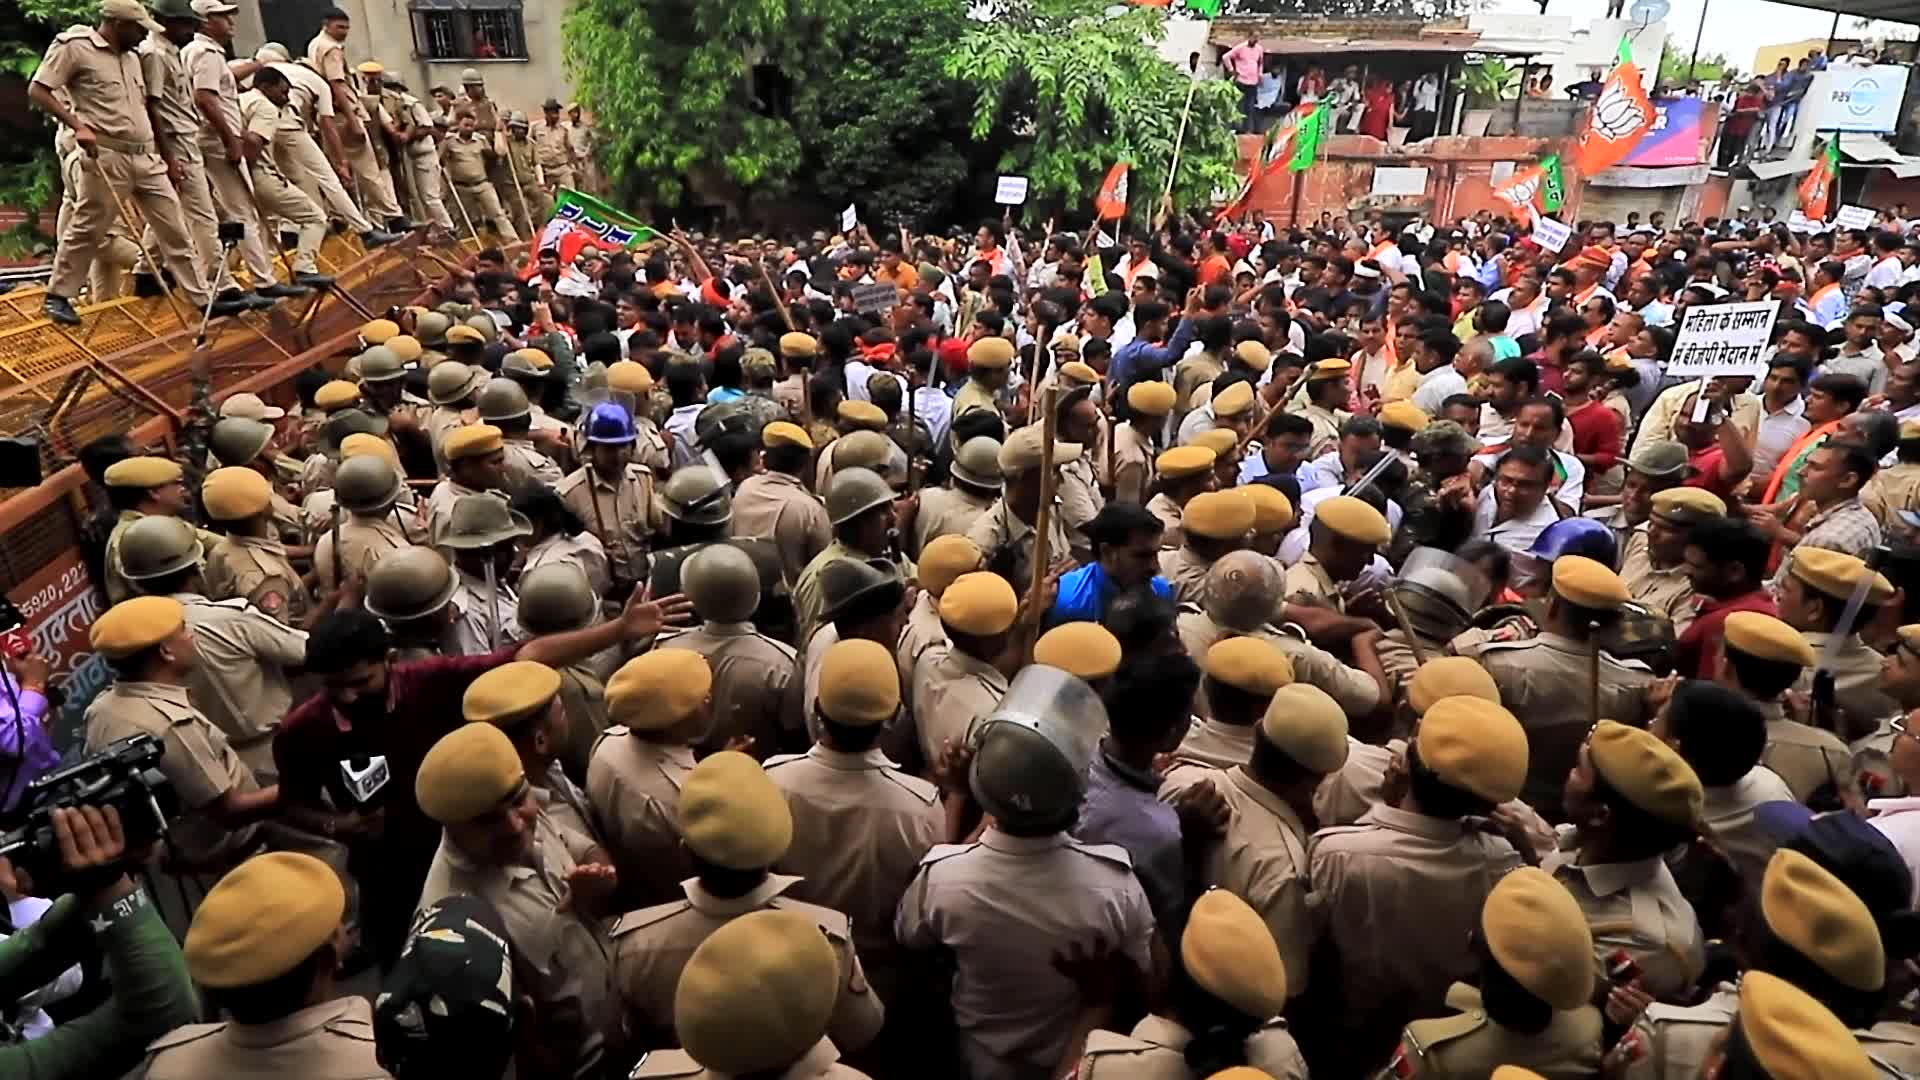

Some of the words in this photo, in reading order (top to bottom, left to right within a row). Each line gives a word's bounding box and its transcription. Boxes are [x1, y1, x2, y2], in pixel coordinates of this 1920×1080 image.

[1685, 309, 1720, 333] महिला
[1719, 306, 1731, 330] के
[1732, 308, 1771, 330] सम्मान
[1683, 341, 1719, 366] बीजेपी
[1717, 341, 1749, 364] मैदान
